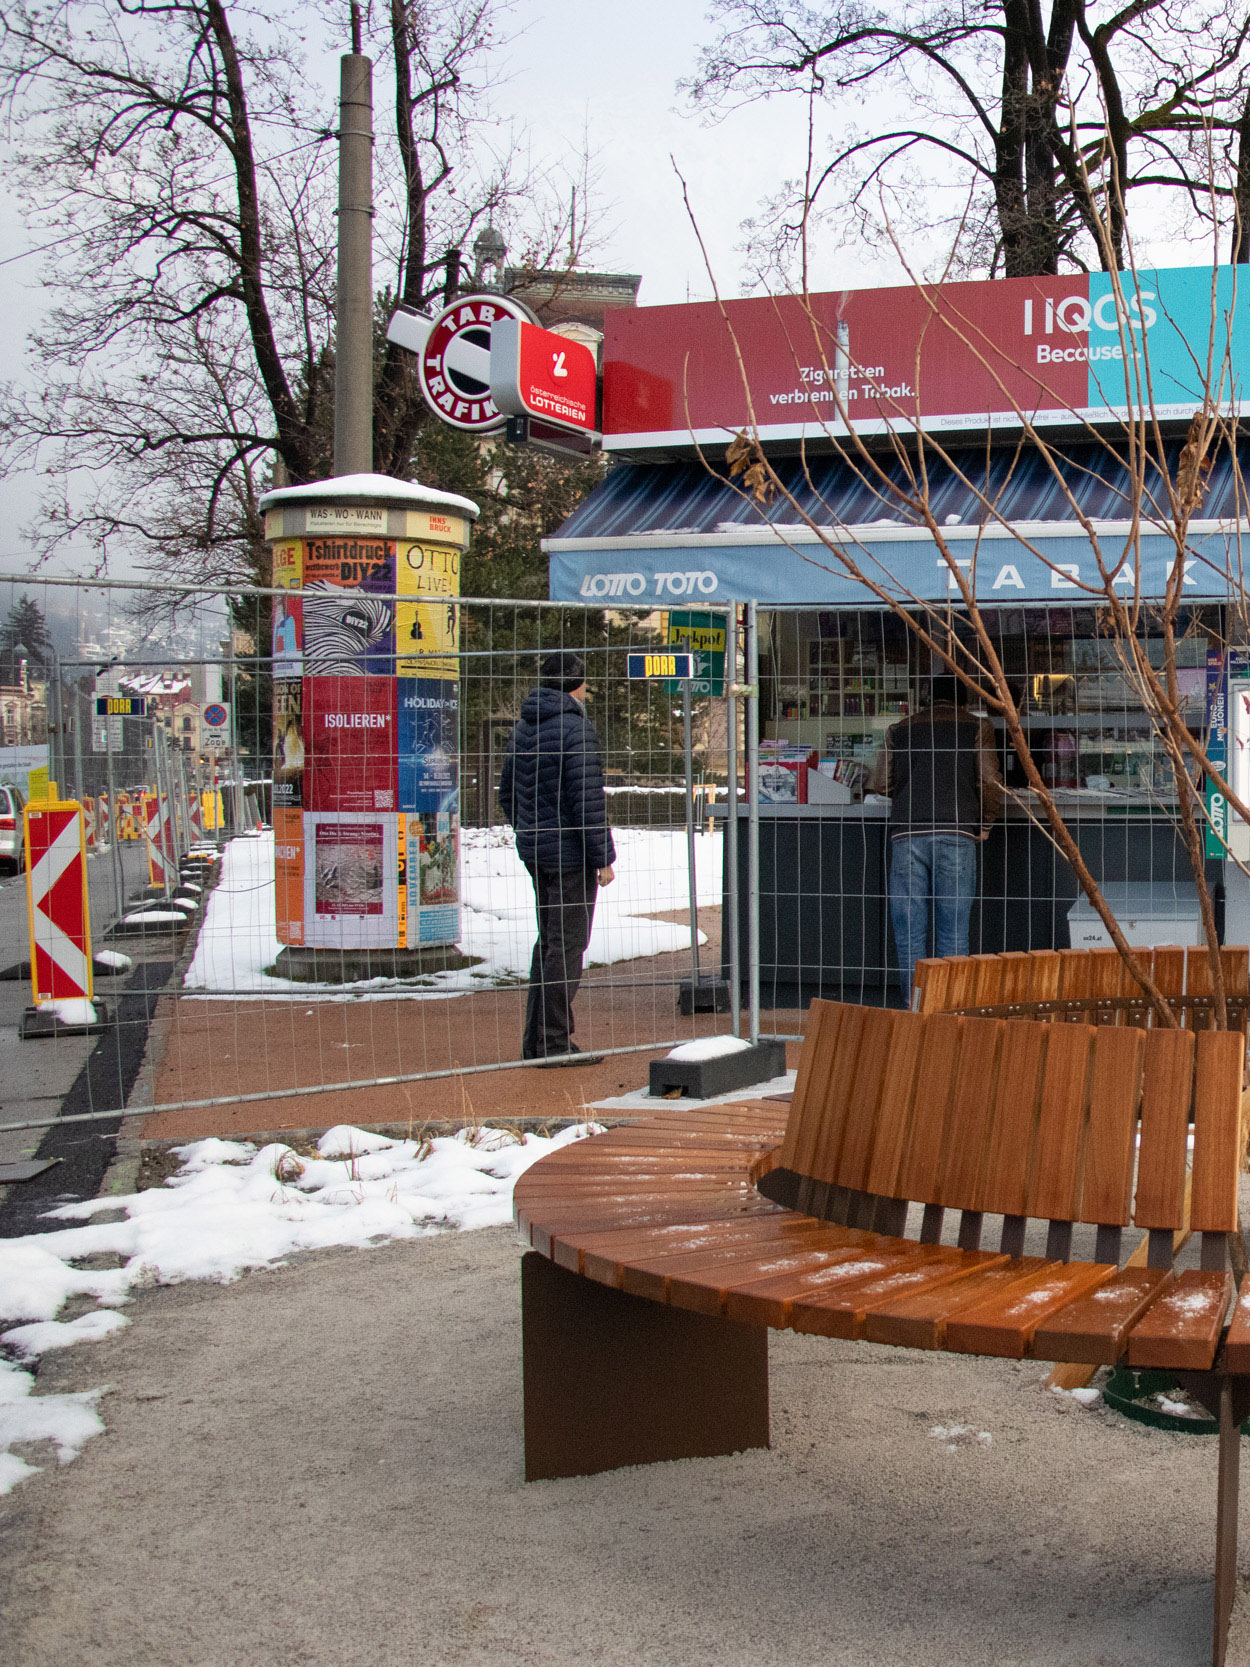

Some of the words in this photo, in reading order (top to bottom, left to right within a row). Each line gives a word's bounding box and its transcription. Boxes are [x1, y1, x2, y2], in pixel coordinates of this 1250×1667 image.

[1036, 344, 1143, 363] Because..
[800, 365, 885, 385] Zigaretten
[530, 385, 587, 411] österreichische
[861, 382, 916, 399] Tabak.
[530, 394, 587, 422] LOTTERIEN
[941, 417, 963, 426] Dieses
[965, 415, 990, 425] Produk
[1060, 408, 1108, 420] ausshließlich
[1136, 407, 1172, 418] Gebauch
[310, 508, 328, 519] WAS
[335, 509, 349, 519] WO
[356, 510, 383, 520] WANN
[429, 524, 451, 533] BRUCK
[307, 541, 393, 560] Tshirtdruck
[407, 545, 459, 575] OTTO
[341, 562, 393, 582] DIY22
[937, 559, 1198, 590] TABAK
[417, 575, 452, 592] LIVE!
[579, 572, 647, 597] LOTTO
[653, 570, 719, 595] TOTO
[644, 655, 677, 678] PORR
[676, 680, 711, 693] LTTO
[106, 698, 132, 715] PORR
[404, 696, 444, 709] HOLIDAY
[409, 840, 418, 907] NOVEMBER
